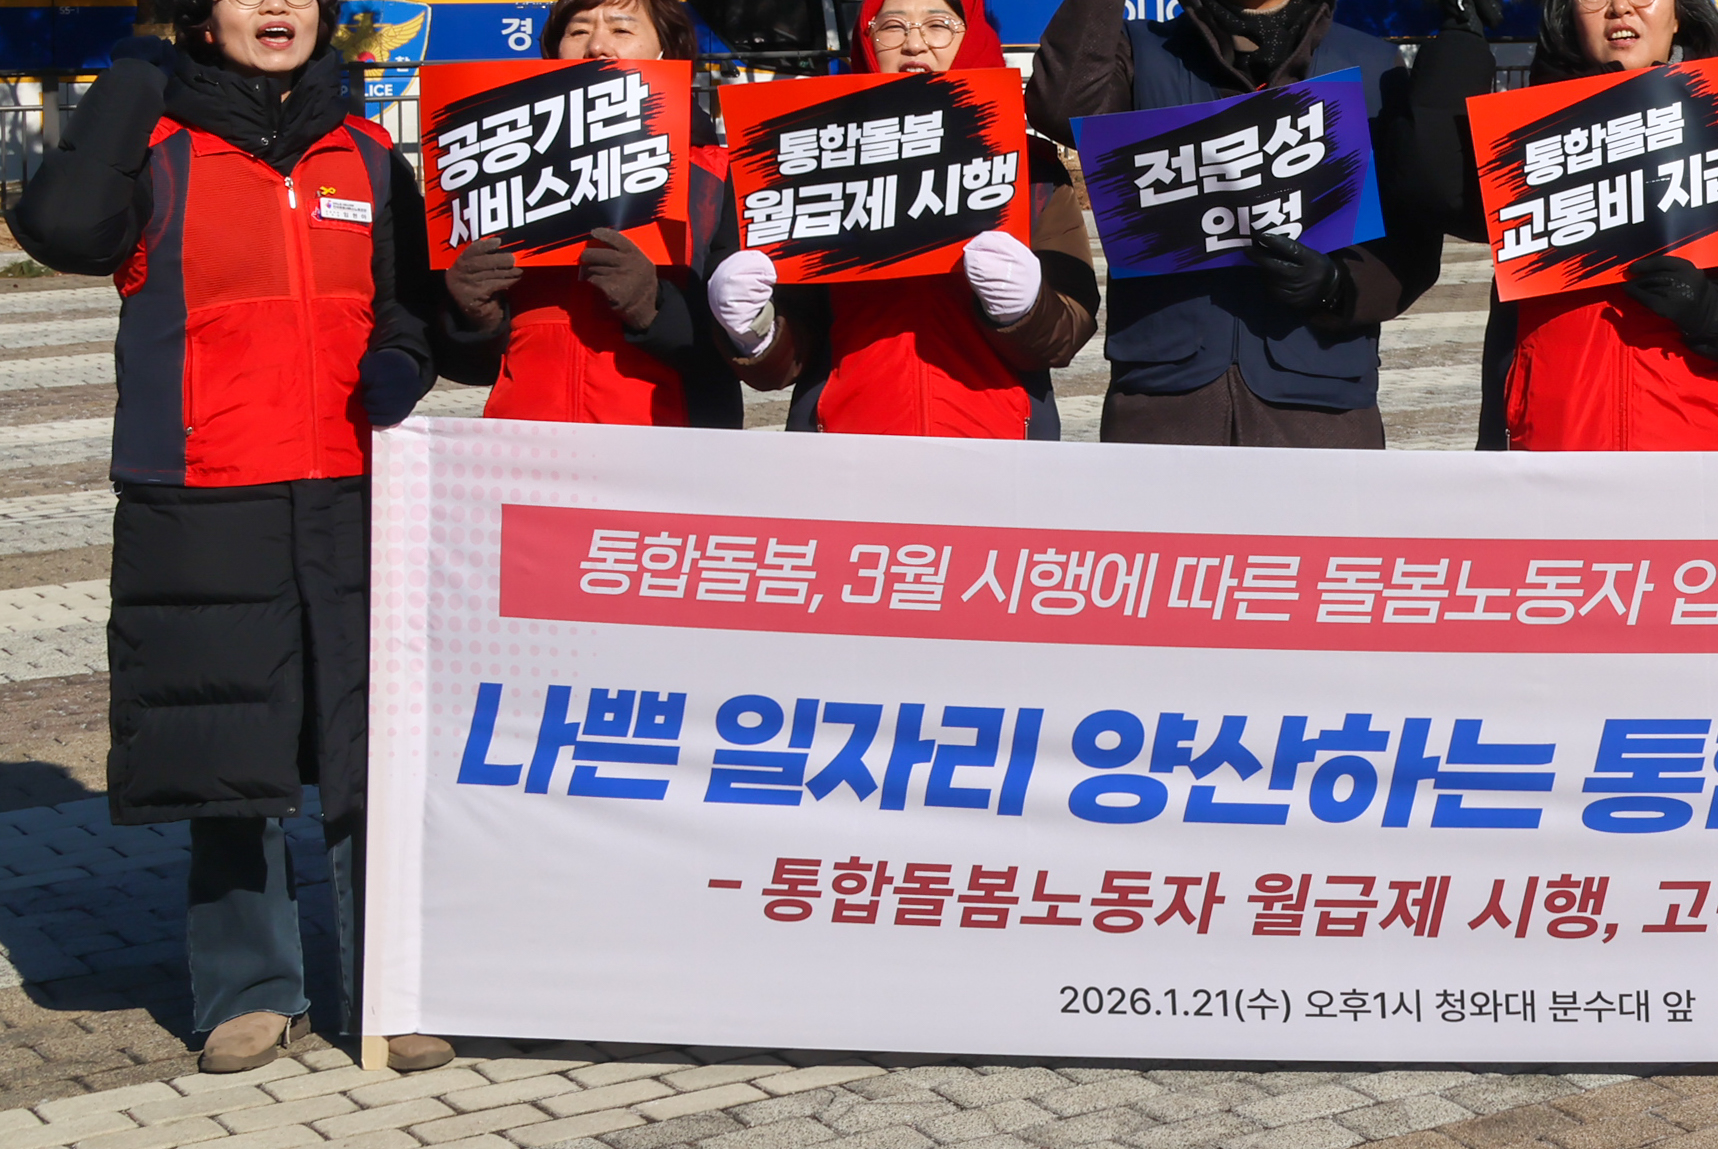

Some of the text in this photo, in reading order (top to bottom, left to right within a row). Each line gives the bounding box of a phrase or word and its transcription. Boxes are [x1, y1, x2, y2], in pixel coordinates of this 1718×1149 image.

[501, 18, 533, 51] 경
[437, 73, 648, 190] 공공기관
[778, 110, 944, 176] 통합돌봄
[1134, 102, 1325, 207] 전문성
[1524, 101, 1685, 185] 통합돌봄
[449, 135, 670, 248] 서비스제공
[744, 152, 1017, 247] 월급제 시행
[1202, 191, 1302, 252] 인정
[1498, 169, 1644, 261] 교통비
[580, 530, 823, 612] 통합돌봄,
[842, 545, 952, 610] 3월
[961, 549, 1156, 619] 시행에
[1168, 555, 1300, 620] 따른
[1317, 557, 1654, 625] 돌봄노동자
[457, 683, 687, 800] 나쁜
[705, 695, 1044, 815] 일자리
[1069, 710, 1556, 828] 양산하는
[763, 857, 1225, 934] 통합돌봄노동자
[1249, 874, 1451, 937] 월급제
[1469, 874, 1618, 943] 시행,
[1060, 986, 1695, 1022] 2026.1.21(수) 오후1시 청와대 분수대 앞
